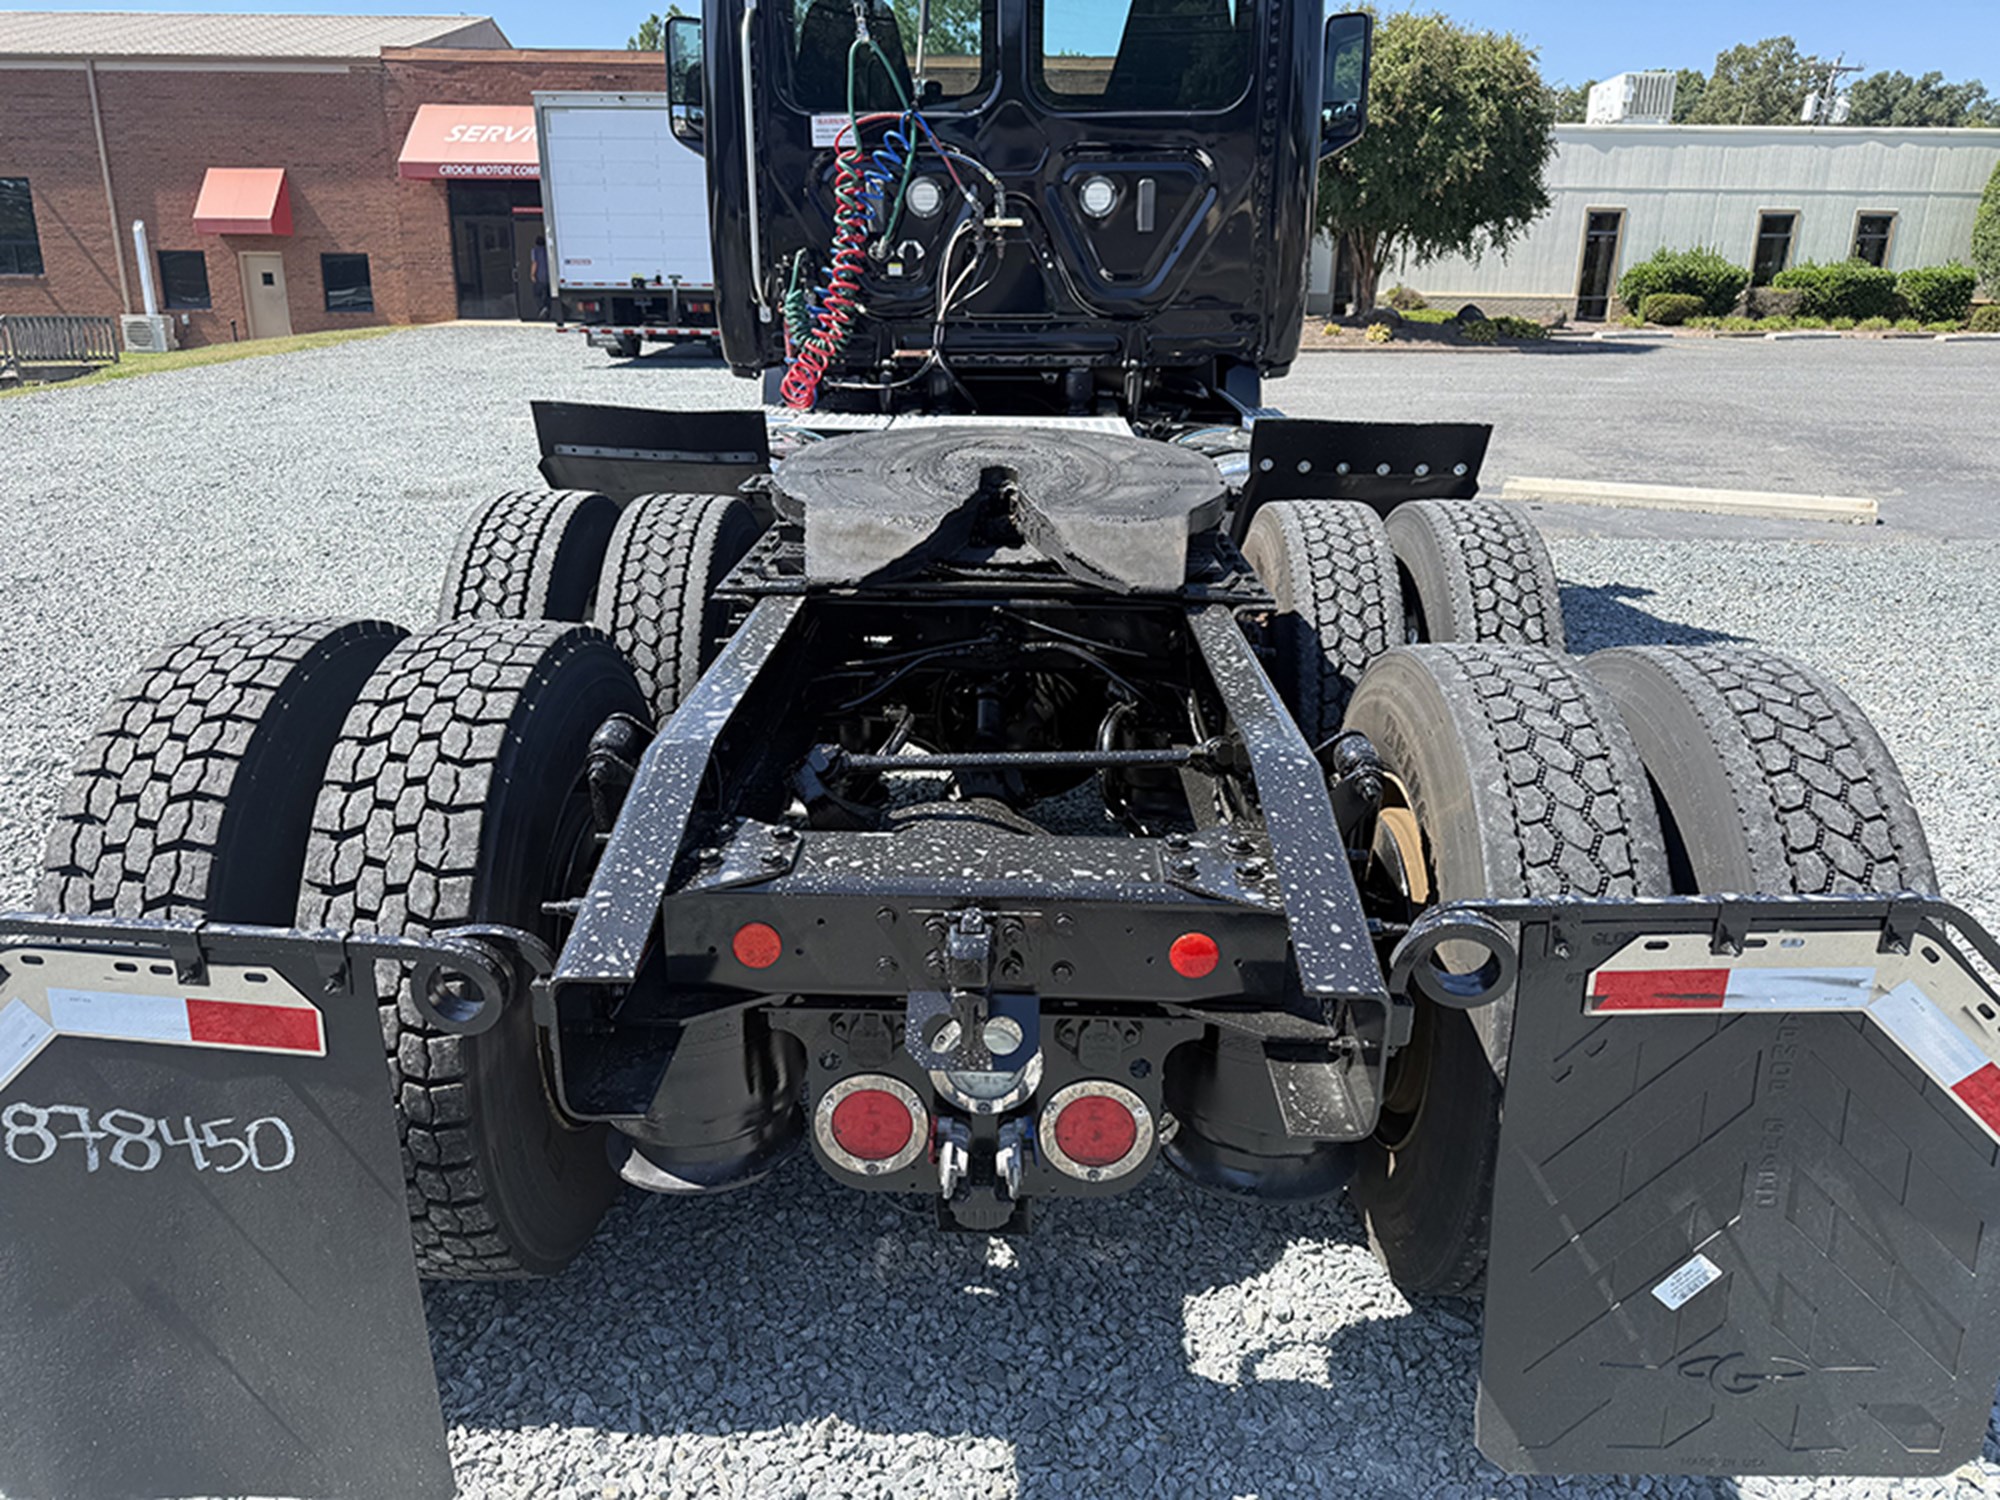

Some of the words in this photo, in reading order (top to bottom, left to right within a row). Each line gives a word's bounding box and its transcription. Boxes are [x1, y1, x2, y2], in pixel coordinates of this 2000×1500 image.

[439, 164, 474, 176] CROOK
[475, 165, 513, 176] MOTOR
[1, 1102, 296, 1172] 878450
